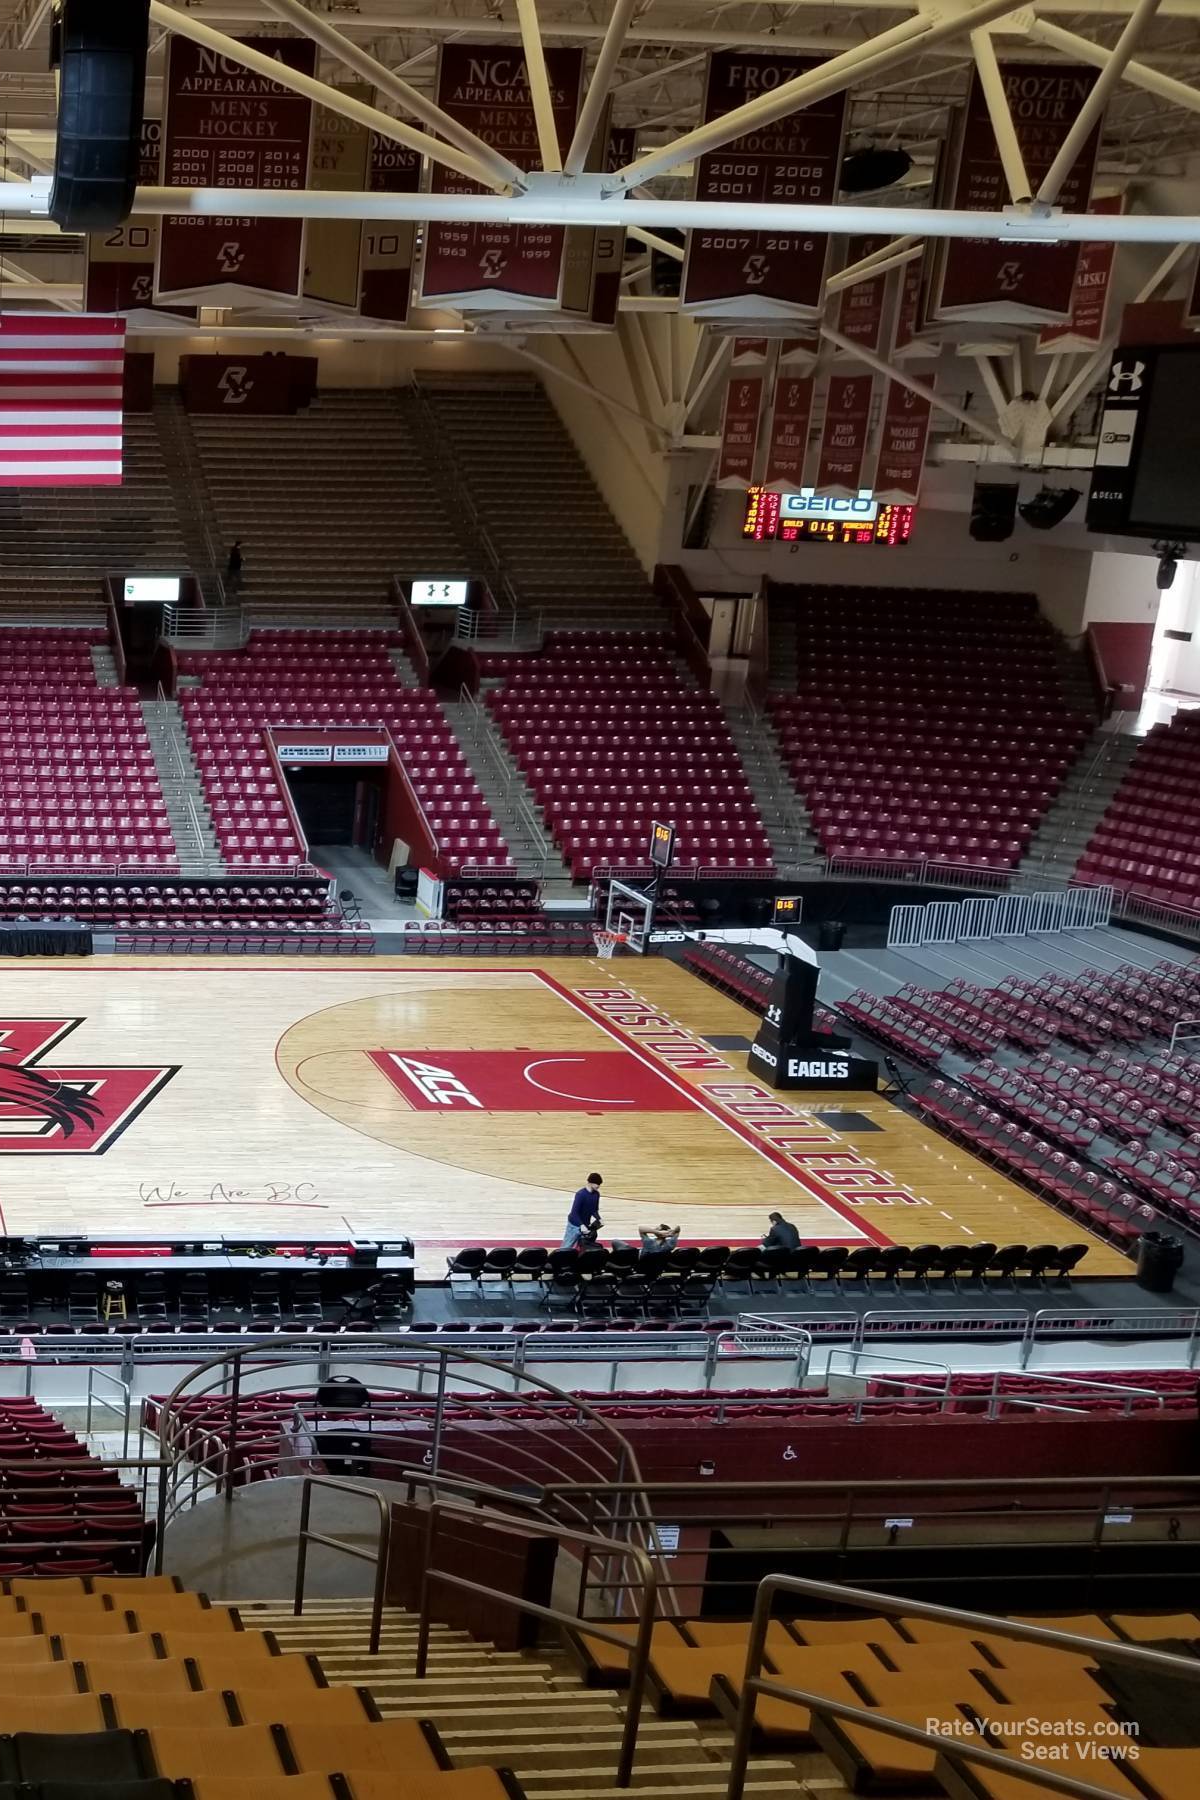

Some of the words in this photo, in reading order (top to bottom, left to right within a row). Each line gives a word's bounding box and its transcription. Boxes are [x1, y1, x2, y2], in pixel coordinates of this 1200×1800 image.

[196, 47, 284, 75] NCA
[467, 58, 555, 87] NCA
[726, 65, 806, 88] FROZ
[180, 74, 297, 93] APPEARANCE
[1006, 77, 1090, 100] ROZEN
[452, 86, 566, 104] APPEARAES
[209, 100, 270, 118] MEN'S
[479, 111, 534, 127] MEN'S
[199, 119, 279, 138] HOCKEY
[1021, 127, 1058, 141] EN'S
[732, 136, 811, 152] HOCKEY
[173, 149, 209, 160] 2000
[218, 150, 255, 160] 2007
[264, 151, 301, 161] 2014
[172, 162, 206, 173] 2001
[218, 163, 254, 174] 2008
[263, 164, 300, 175] 2015
[444, 170, 472, 181] 194
[709, 164, 759, 177] 2000
[171, 175, 207, 186] 2003
[217, 176, 254, 187] 2010
[263, 177, 299, 188] 2016
[708, 182, 752, 194] 2001
[772, 184, 821, 197] 2010
[169, 216, 205, 226] 2006
[215, 217, 251, 227] 2013
[439, 231, 468, 242] 1959
[701, 238, 751, 250] 2007
[766, 239, 814, 251] 2016
[438, 247, 467, 257] 1963
[522, 250, 551, 259] 1999
[1099, 491, 1123, 499] DELTA
[788, 496, 872, 512] GEICO
[783, 528, 797, 539] 32
[856, 531, 870, 542] 36
[650, 933, 685, 943] GEICO
[572, 987, 734, 1073] BOSTON
[751, 1043, 778, 1068] GEICO
[788, 1059, 849, 1079] EAGLES
[401, 1056, 485, 1109] ACC
[699, 1081, 923, 1207] COLLEGE
[138, 1181, 190, 1202] We
[203, 1182, 251, 1203] Are
[263, 1181, 320, 1203] BC
